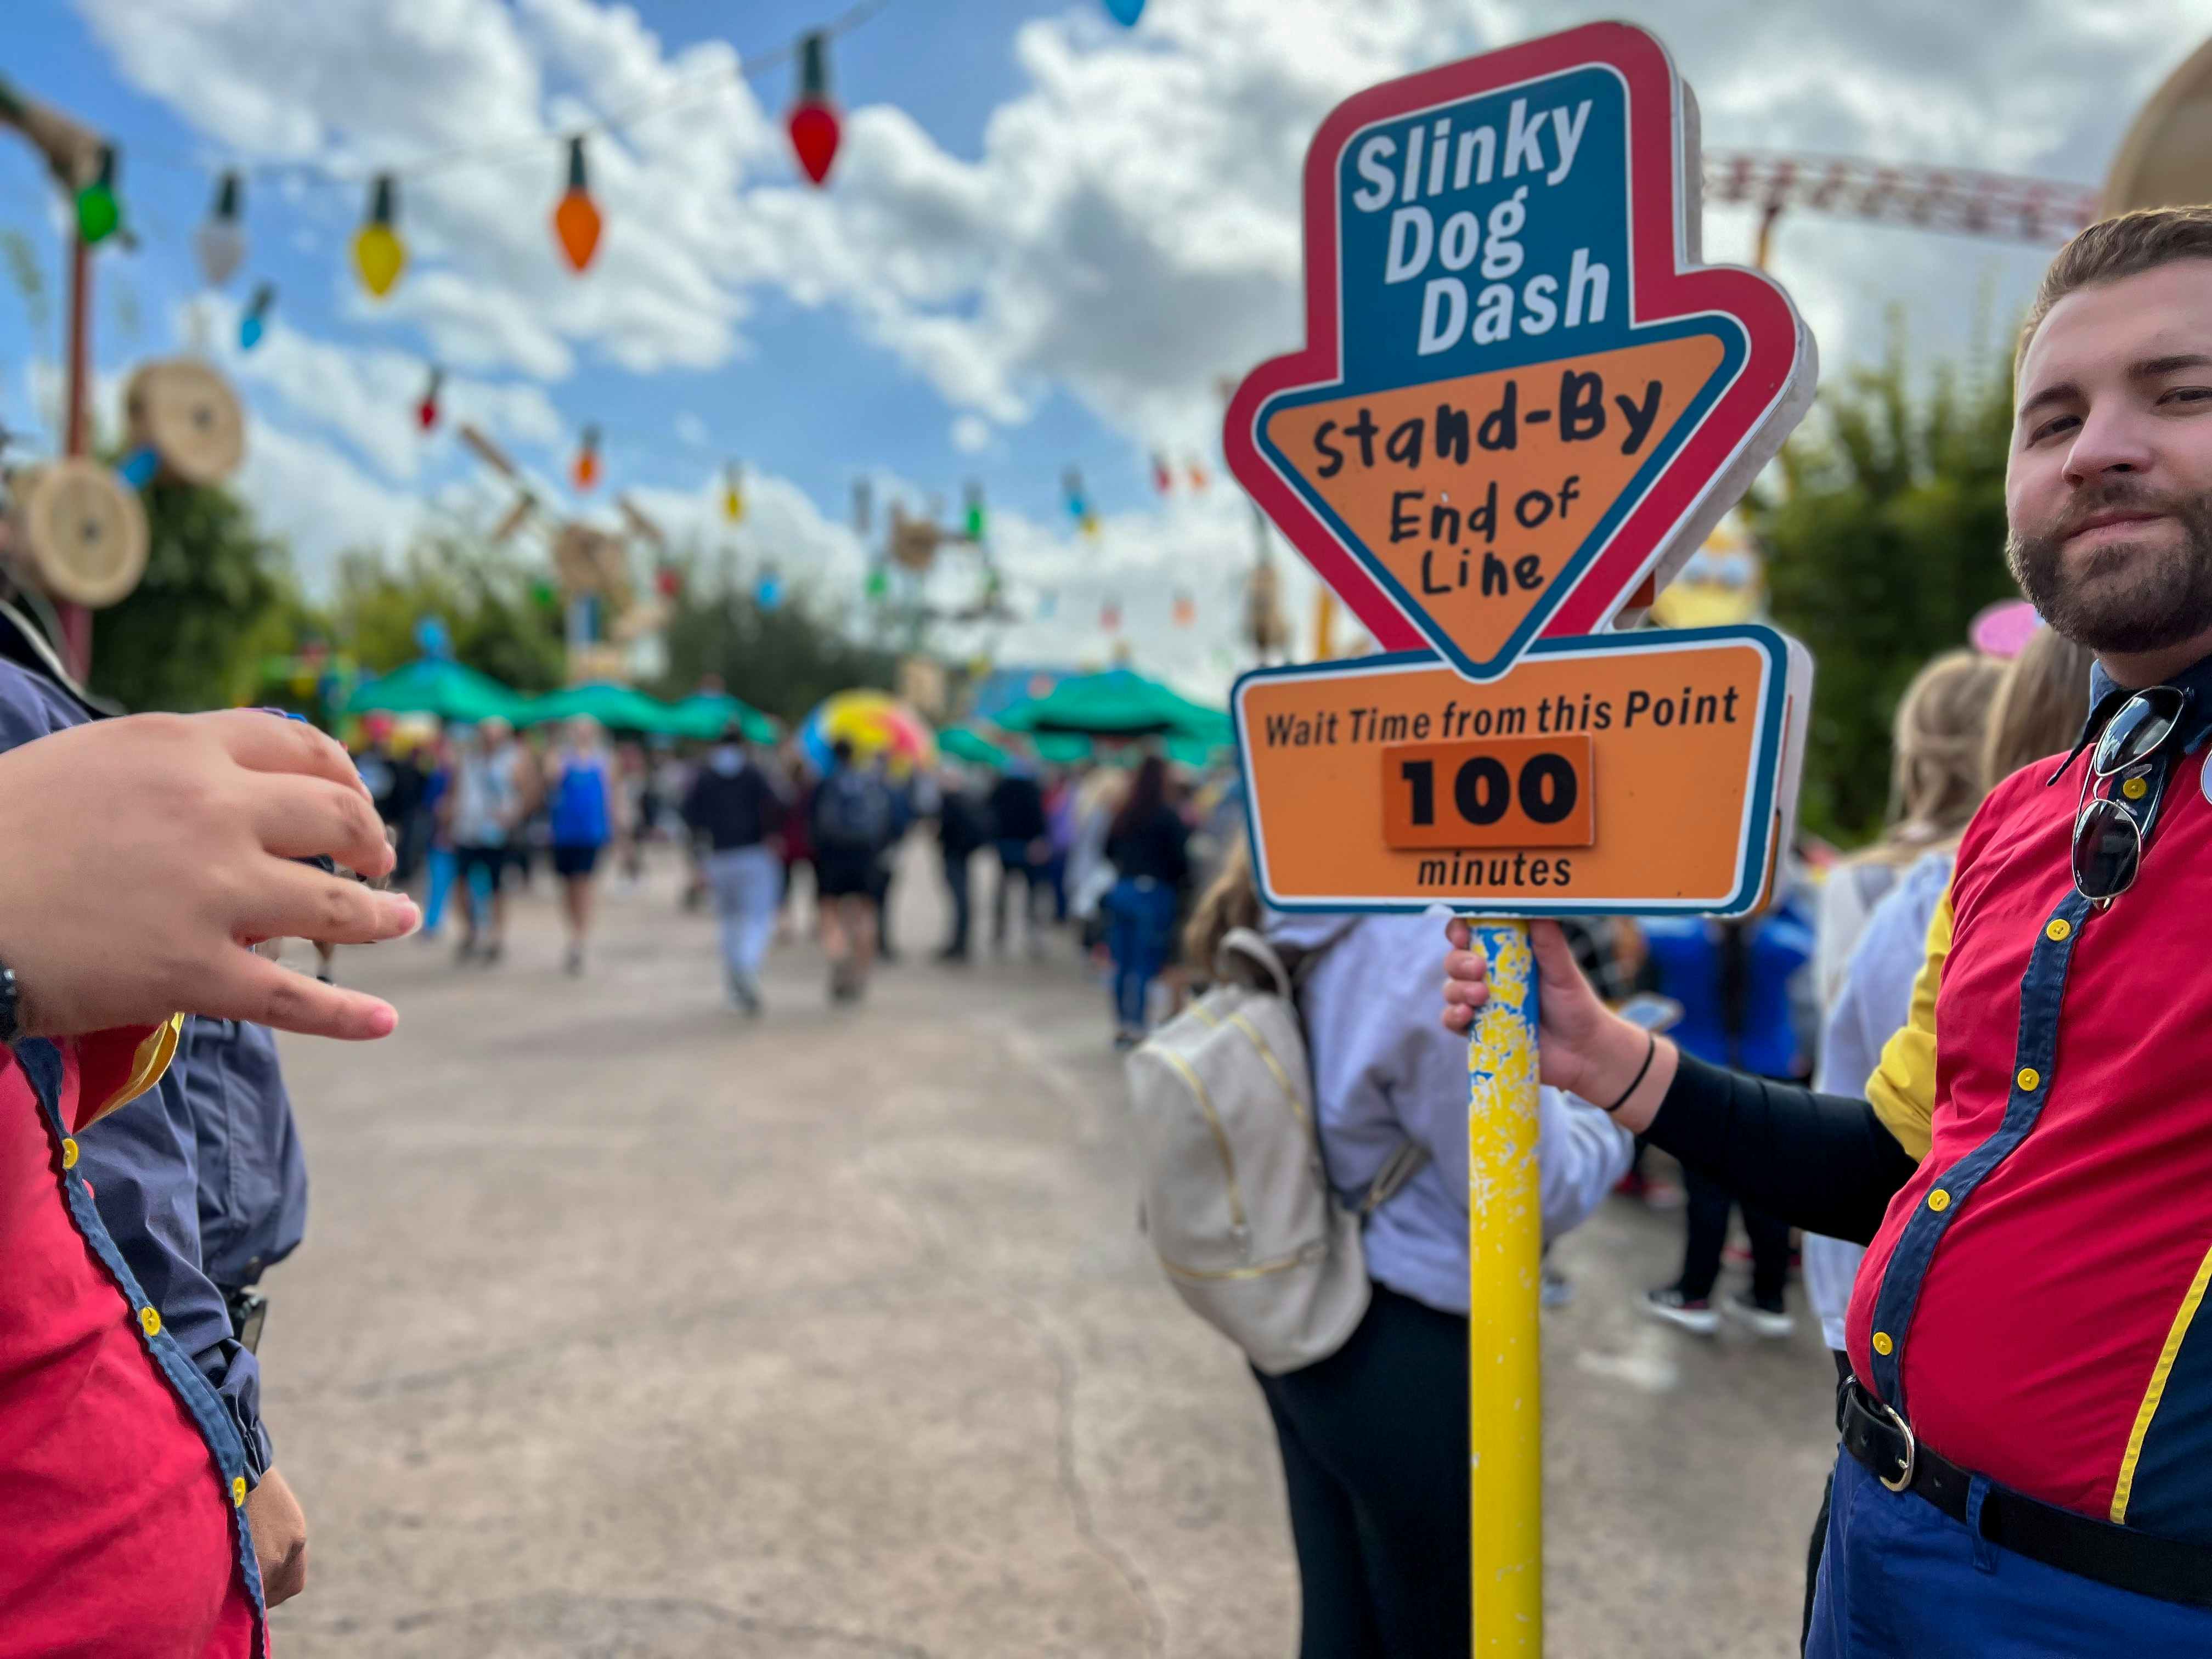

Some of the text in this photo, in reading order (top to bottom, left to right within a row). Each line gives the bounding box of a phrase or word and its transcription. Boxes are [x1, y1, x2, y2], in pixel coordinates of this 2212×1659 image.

[1352, 98, 1593, 213] Slinky
[1384, 186, 1528, 285] Dog
[1417, 247, 1610, 356] Dash
[1389, 474, 1581, 545] End of
[1420, 549, 1545, 596] Line
[1266, 685, 1739, 747] Wait Time from this Point
[1400, 751, 1579, 828] 100
[1418, 850, 1572, 887] minutes
